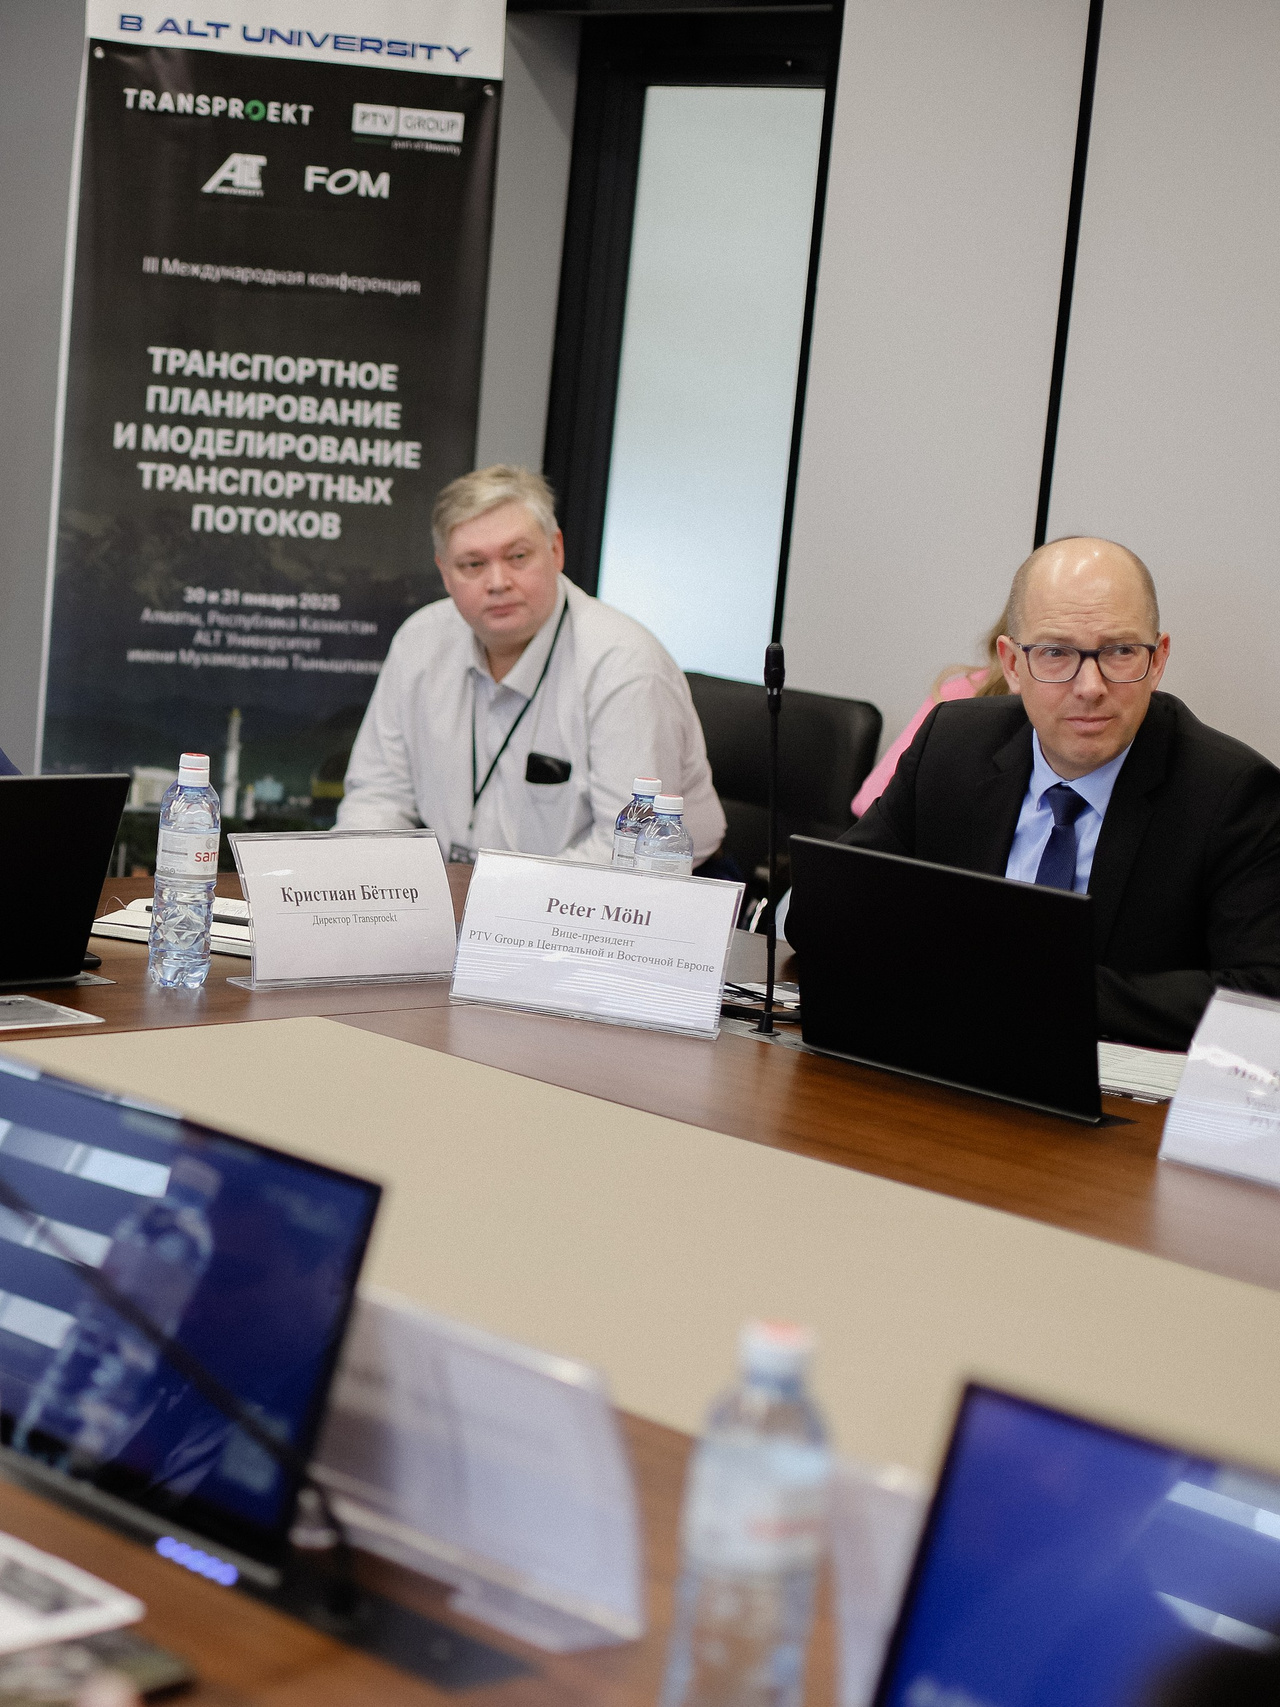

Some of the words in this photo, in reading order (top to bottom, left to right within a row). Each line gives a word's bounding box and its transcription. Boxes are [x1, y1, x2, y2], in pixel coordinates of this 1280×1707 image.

[158, 18, 231, 38] ALT
[242, 25, 472, 63] UNIVERSITY
[123, 88, 314, 126] TRANSPROEKT
[304, 165, 391, 199] FOM
[147, 345, 400, 391] ТРАНСПОРТНОЕ
[145, 385, 402, 430] ПЛАНИРОВАНИЕ
[113, 422, 137, 450] И
[141, 424, 422, 469] МОДЕЛИРОВАНИЕ
[137, 462, 394, 505] ТРАНСПОРТНЫХ
[191, 504, 342, 540] ПОТОКОВ
[280, 886, 357, 907] Кристиан
[359, 884, 419, 904] Бёттгер
[546, 897, 596, 919] Peter
[600, 904, 652, 926] Möhl
[312, 915, 351, 926] Директор
[351, 913, 398, 925] Transproekt
[551, 926, 635, 948] Вице-президент
[468, 929, 492, 941] PTV
[494, 933, 526, 948] Group
[536, 938, 605, 958] Центральной
[607, 951, 614, 959] и
[617, 950, 674, 967] Восточной
[676, 957, 715, 973] Европе
